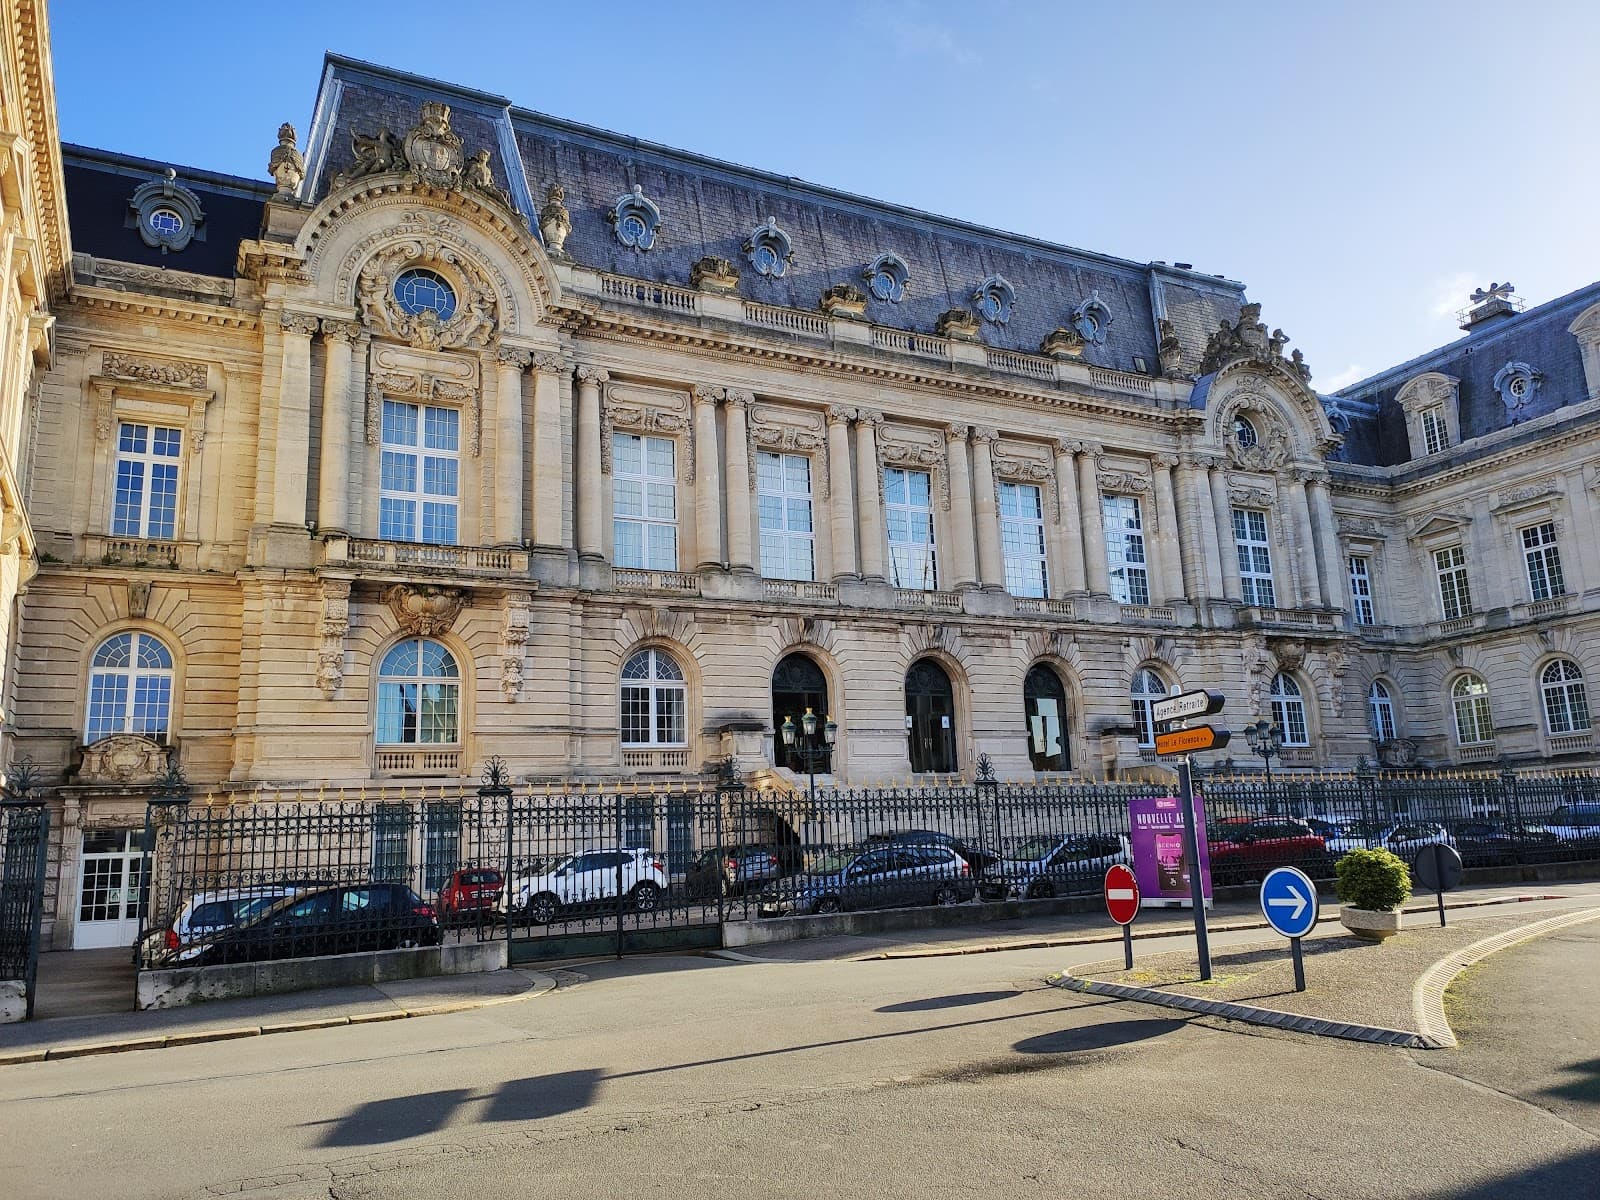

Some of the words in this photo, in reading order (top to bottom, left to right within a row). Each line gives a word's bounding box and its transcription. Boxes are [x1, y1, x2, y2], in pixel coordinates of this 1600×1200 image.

[1157, 705, 1178, 719] Agence
[1179, 699, 1203, 712] Retraite
[1137, 813, 1172, 825] NOUVELLE
